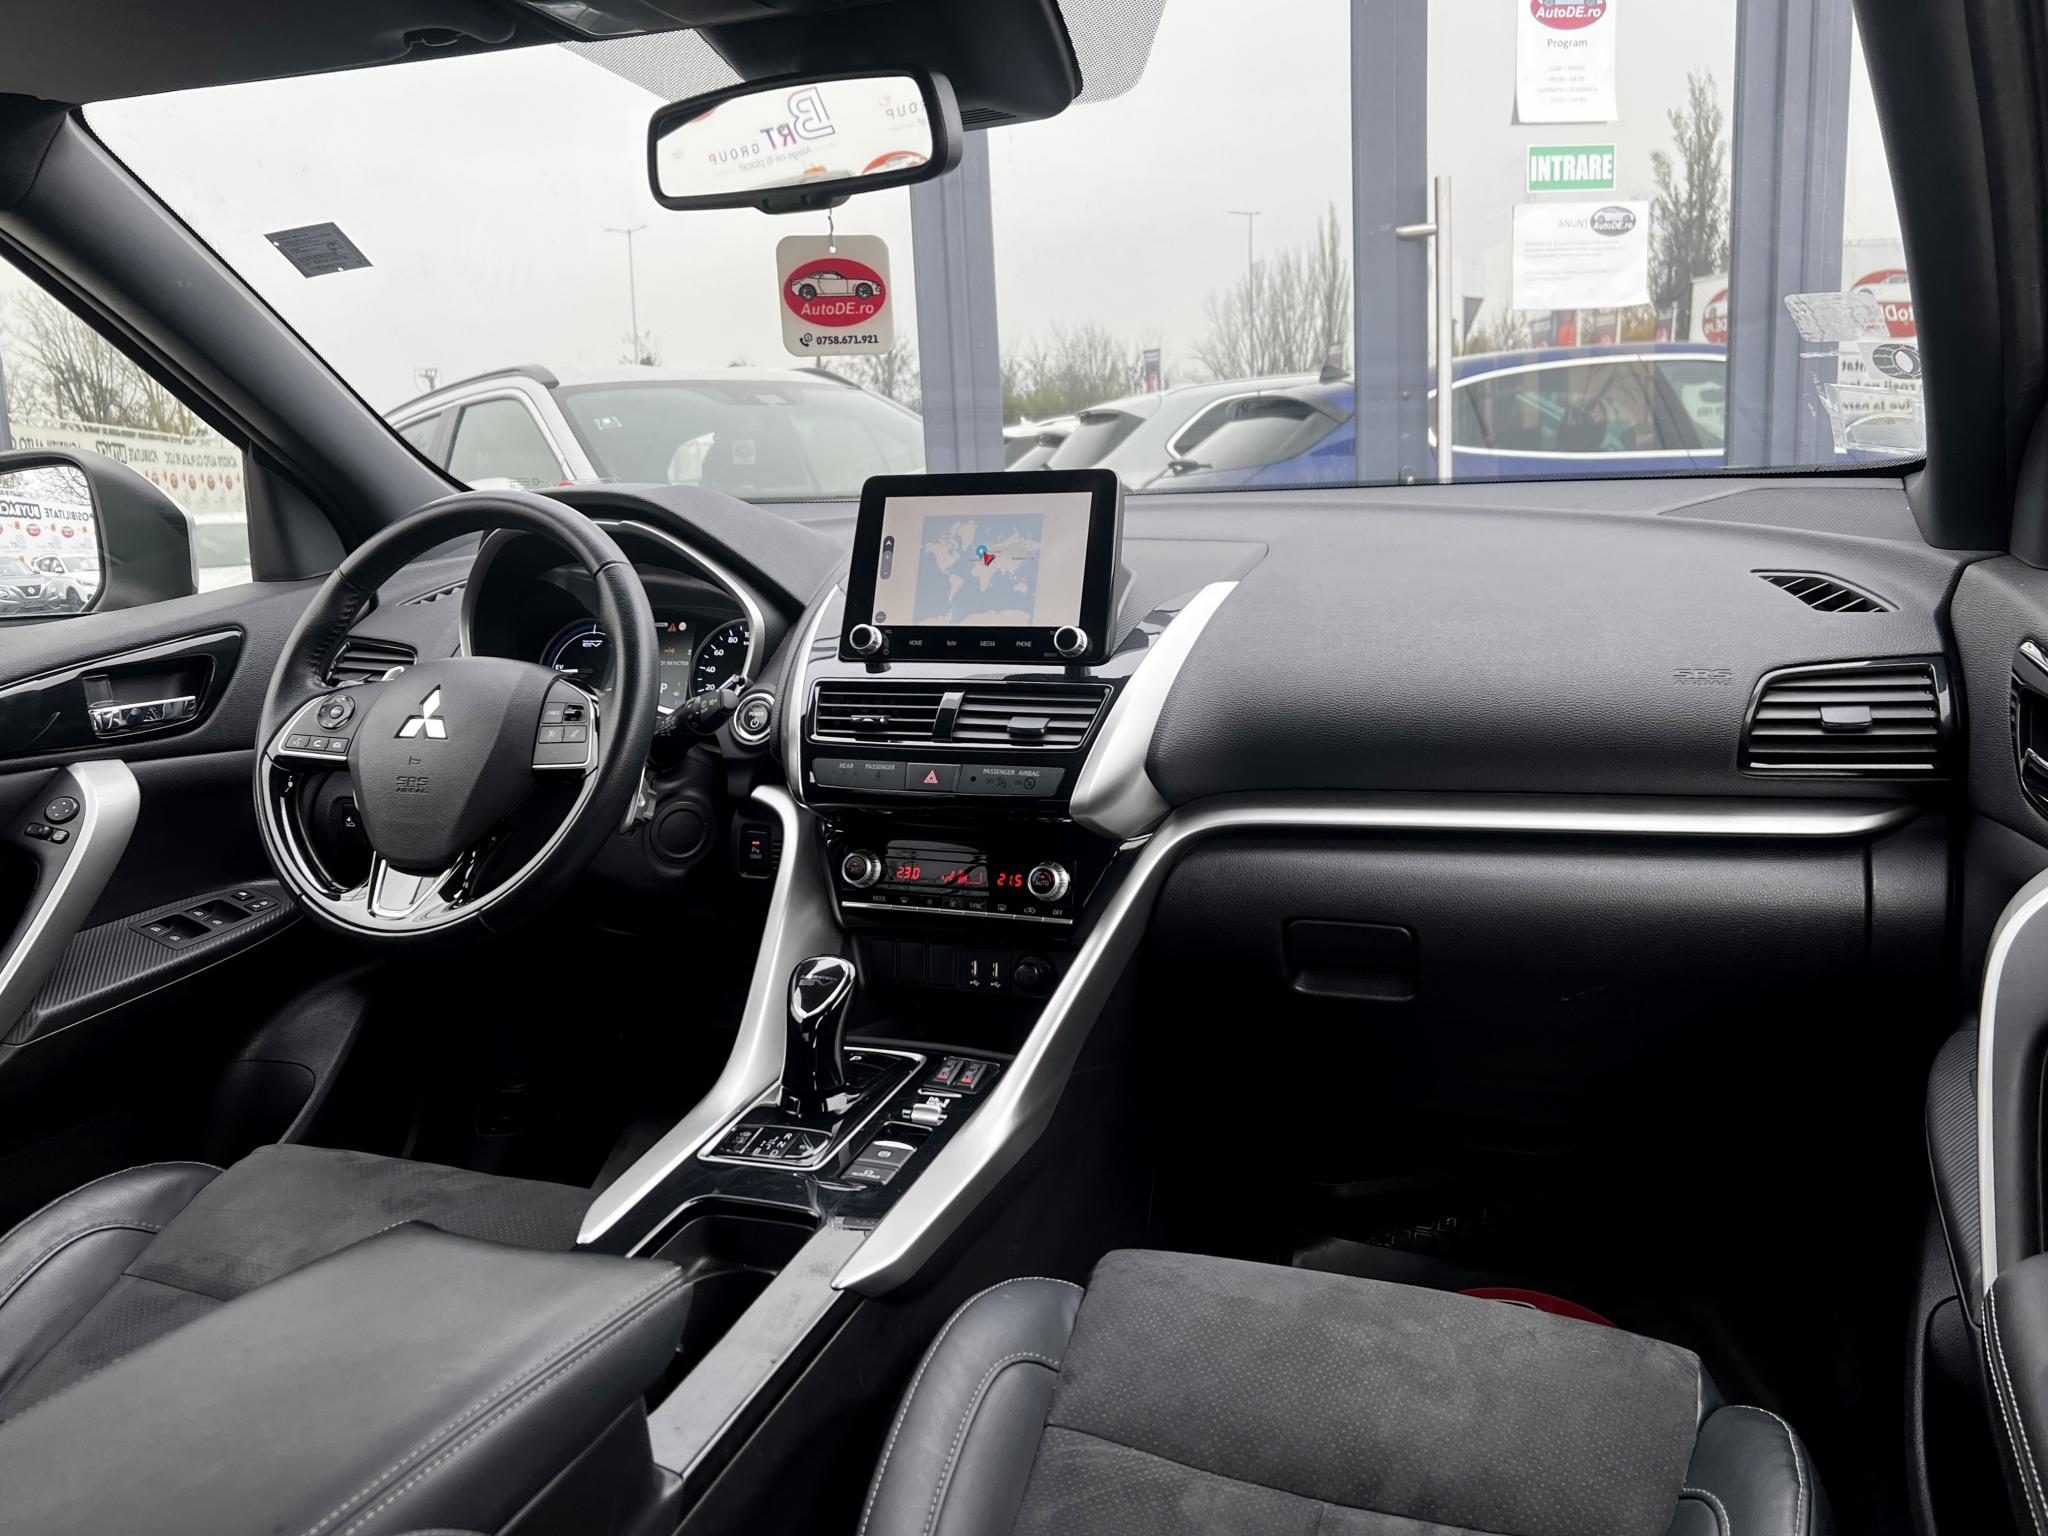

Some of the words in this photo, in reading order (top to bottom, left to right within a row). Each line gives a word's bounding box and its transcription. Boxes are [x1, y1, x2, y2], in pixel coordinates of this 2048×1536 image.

[1535, 5, 1602, 20] AutoDE.ro
[1547, 37, 1588, 49] Program
[1530, 153, 1614, 182] INTRARE
[800, 301, 875, 317] AutoDE.ro
[815, 333, 879, 346] 0758.671.921
[728, 636, 739, 644] 80
[909, 639, 923, 647] HOME
[979, 639, 996, 647] MEDIA
[1015, 640, 1032, 648] PHONE
[705, 665, 716, 673] 40
[660, 683, 668, 694] P
[705, 683, 716, 691] 20
[865, 763, 896, 771] PASSENGER
[982, 768, 1016, 776] PASSENGER
[1018, 769, 1040, 778] AIRBAG
[396, 776, 429, 786] SRS
[1052, 908, 1063, 917] OFF
